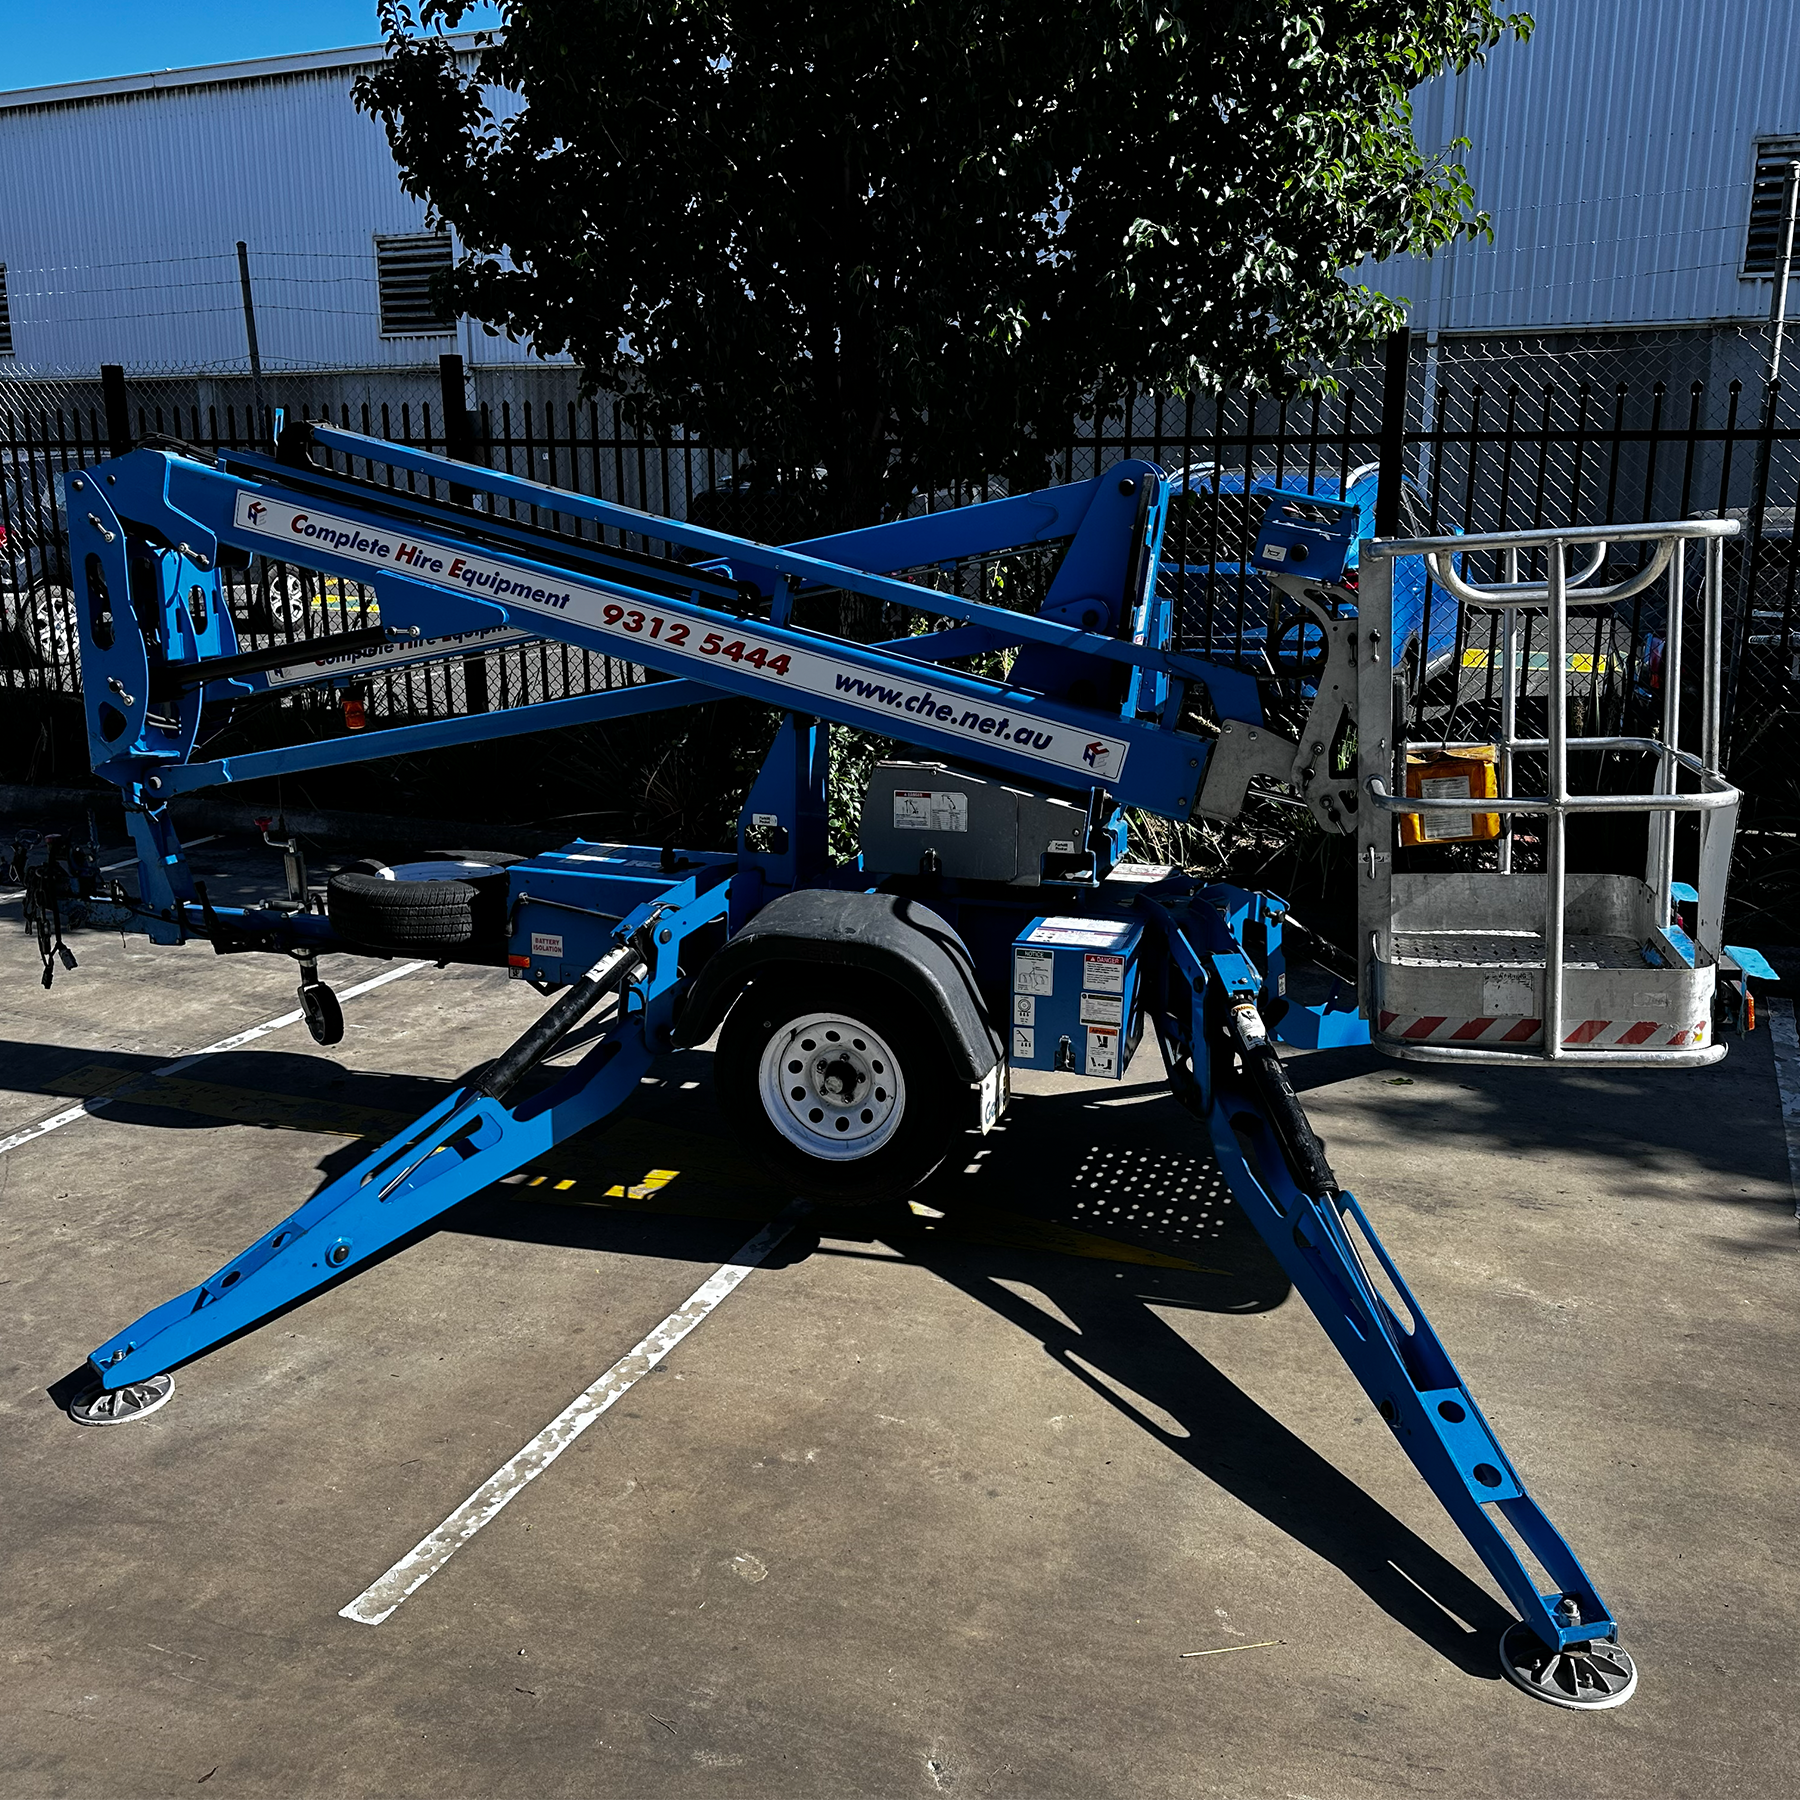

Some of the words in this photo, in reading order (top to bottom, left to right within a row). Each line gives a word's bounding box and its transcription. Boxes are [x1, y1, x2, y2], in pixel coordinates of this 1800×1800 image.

[291, 514, 390, 558] Complete
[394, 543, 443, 573] Hire
[448, 558, 570, 609] Equipment
[603, 604, 691, 647] 9312
[699, 633, 792, 676] 5444
[835, 673, 1053, 750] www.che.net.au
[535, 937, 560, 946] BATTERY
[533, 944, 562, 953] ISOLATION
[1024, 950, 1044, 958] NOTICE
[1096, 956, 1120, 964] DANGER
